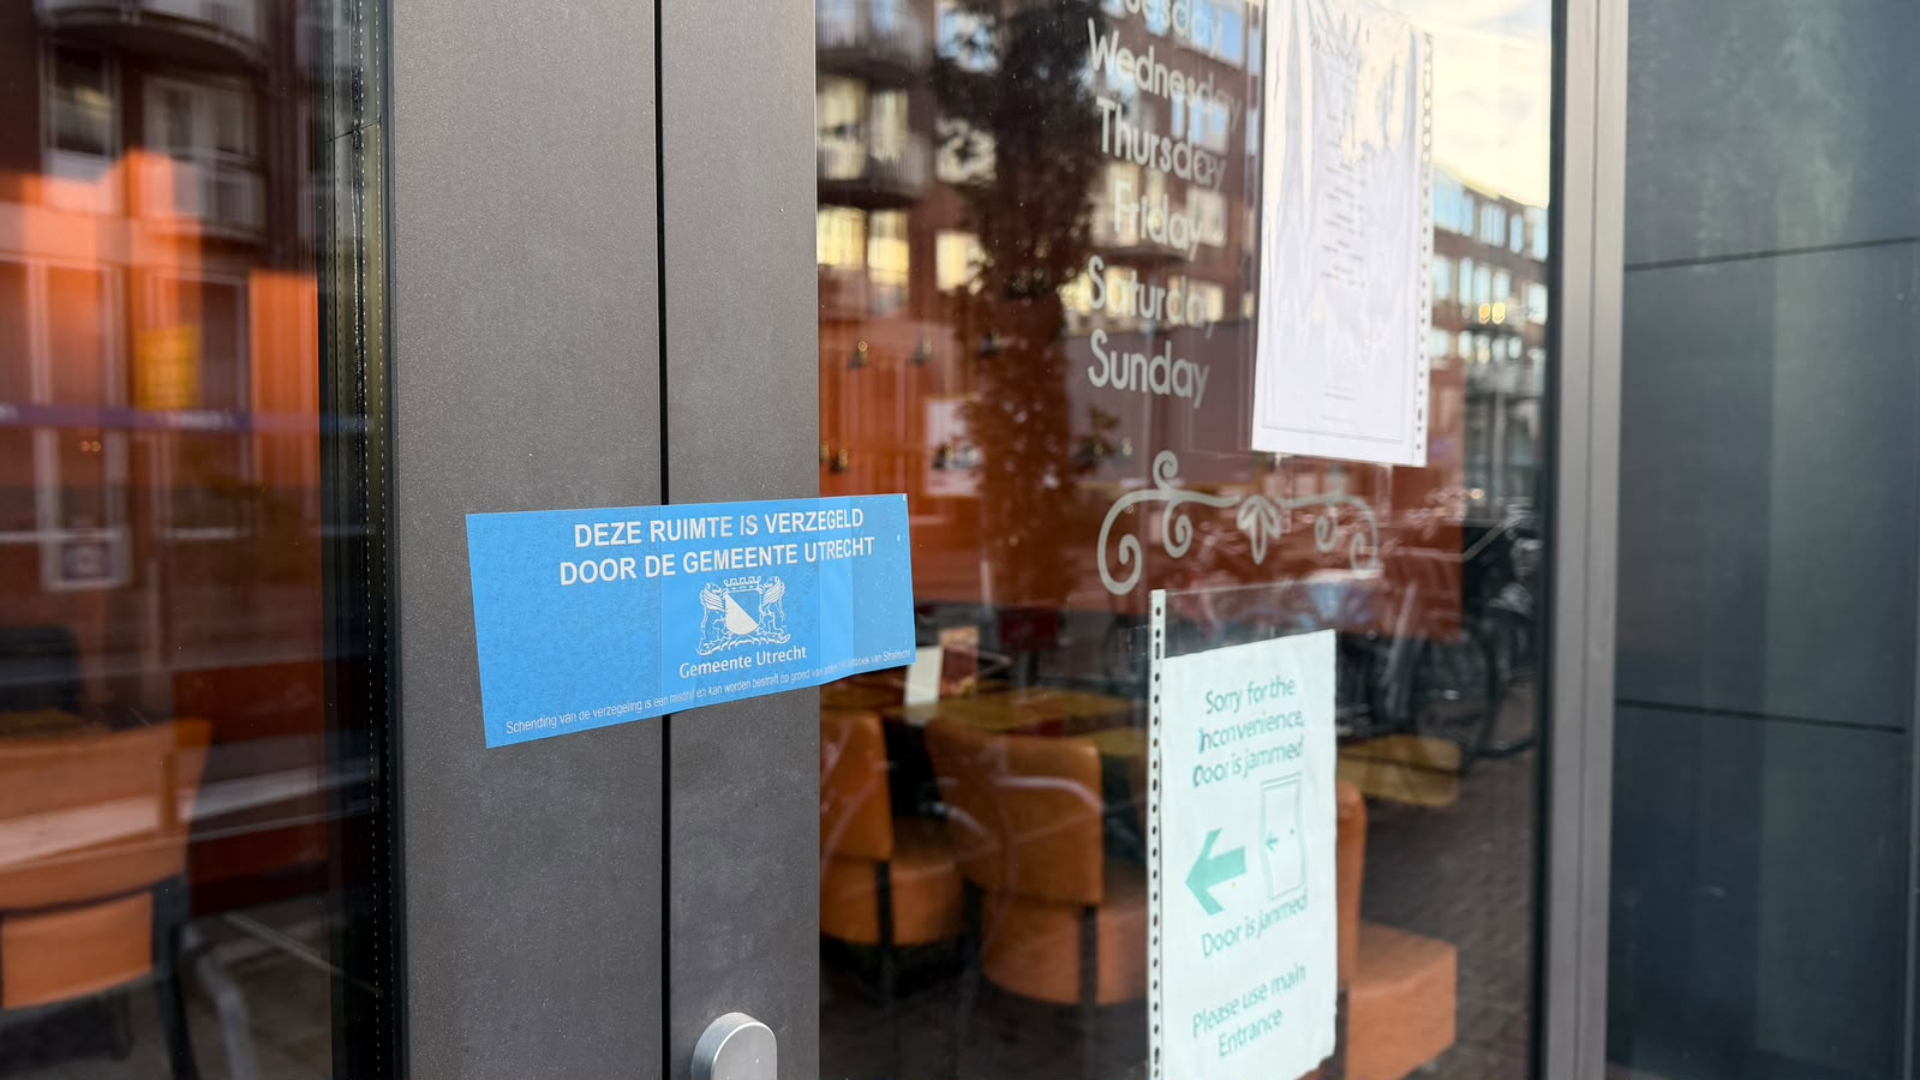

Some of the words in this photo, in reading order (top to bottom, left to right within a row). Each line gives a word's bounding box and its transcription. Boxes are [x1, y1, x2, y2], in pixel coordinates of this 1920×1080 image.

[1112, 0, 1222, 59] esday
[1087, 16, 1242, 133] Wednesday
[1096, 96, 1227, 192] Thursday
[1114, 180, 1203, 263] Friday
[1088, 255, 1217, 340] Saturday
[1087, 328, 1210, 409] Sunday
[574, 521, 642, 548] DEZE
[650, 516, 734, 543] RUIMTE
[740, 514, 758, 536] IS
[764, 508, 864, 533] VERZEGELD
[560, 557, 637, 586] DOOR
[645, 553, 676, 578] DE
[683, 544, 798, 574] GEMEENTE
[804, 537, 875, 563] UTRECHT
[679, 655, 752, 679] Gemeente
[756, 645, 808, 666] Utrecht
[506, 713, 558, 734] Schending
[559, 713, 577, 724] van
[579, 709, 591, 721] de
[592, 700, 642, 718] verzegeling
[644, 697, 652, 709] is
[653, 696, 668, 707] een
[696, 689, 707, 698] en
[708, 684, 723, 696] kan
[725, 681, 751, 693] worden
[1205, 689, 1243, 715] Sorry
[1247, 681, 1268, 705] for
[1269, 674, 1295, 699] the
[1192, 764, 1229, 788] Door
[1231, 752, 1242, 775] is
[1243, 733, 1304, 778] jammed
[1201, 924, 1242, 958] Door
[1244, 915, 1256, 939] is
[1257, 888, 1308, 939] jammed
[1192, 998, 1240, 1038] Please
[1243, 983, 1268, 1009] use
[1271, 963, 1306, 996] main
[1218, 1008, 1283, 1057] Entrance
